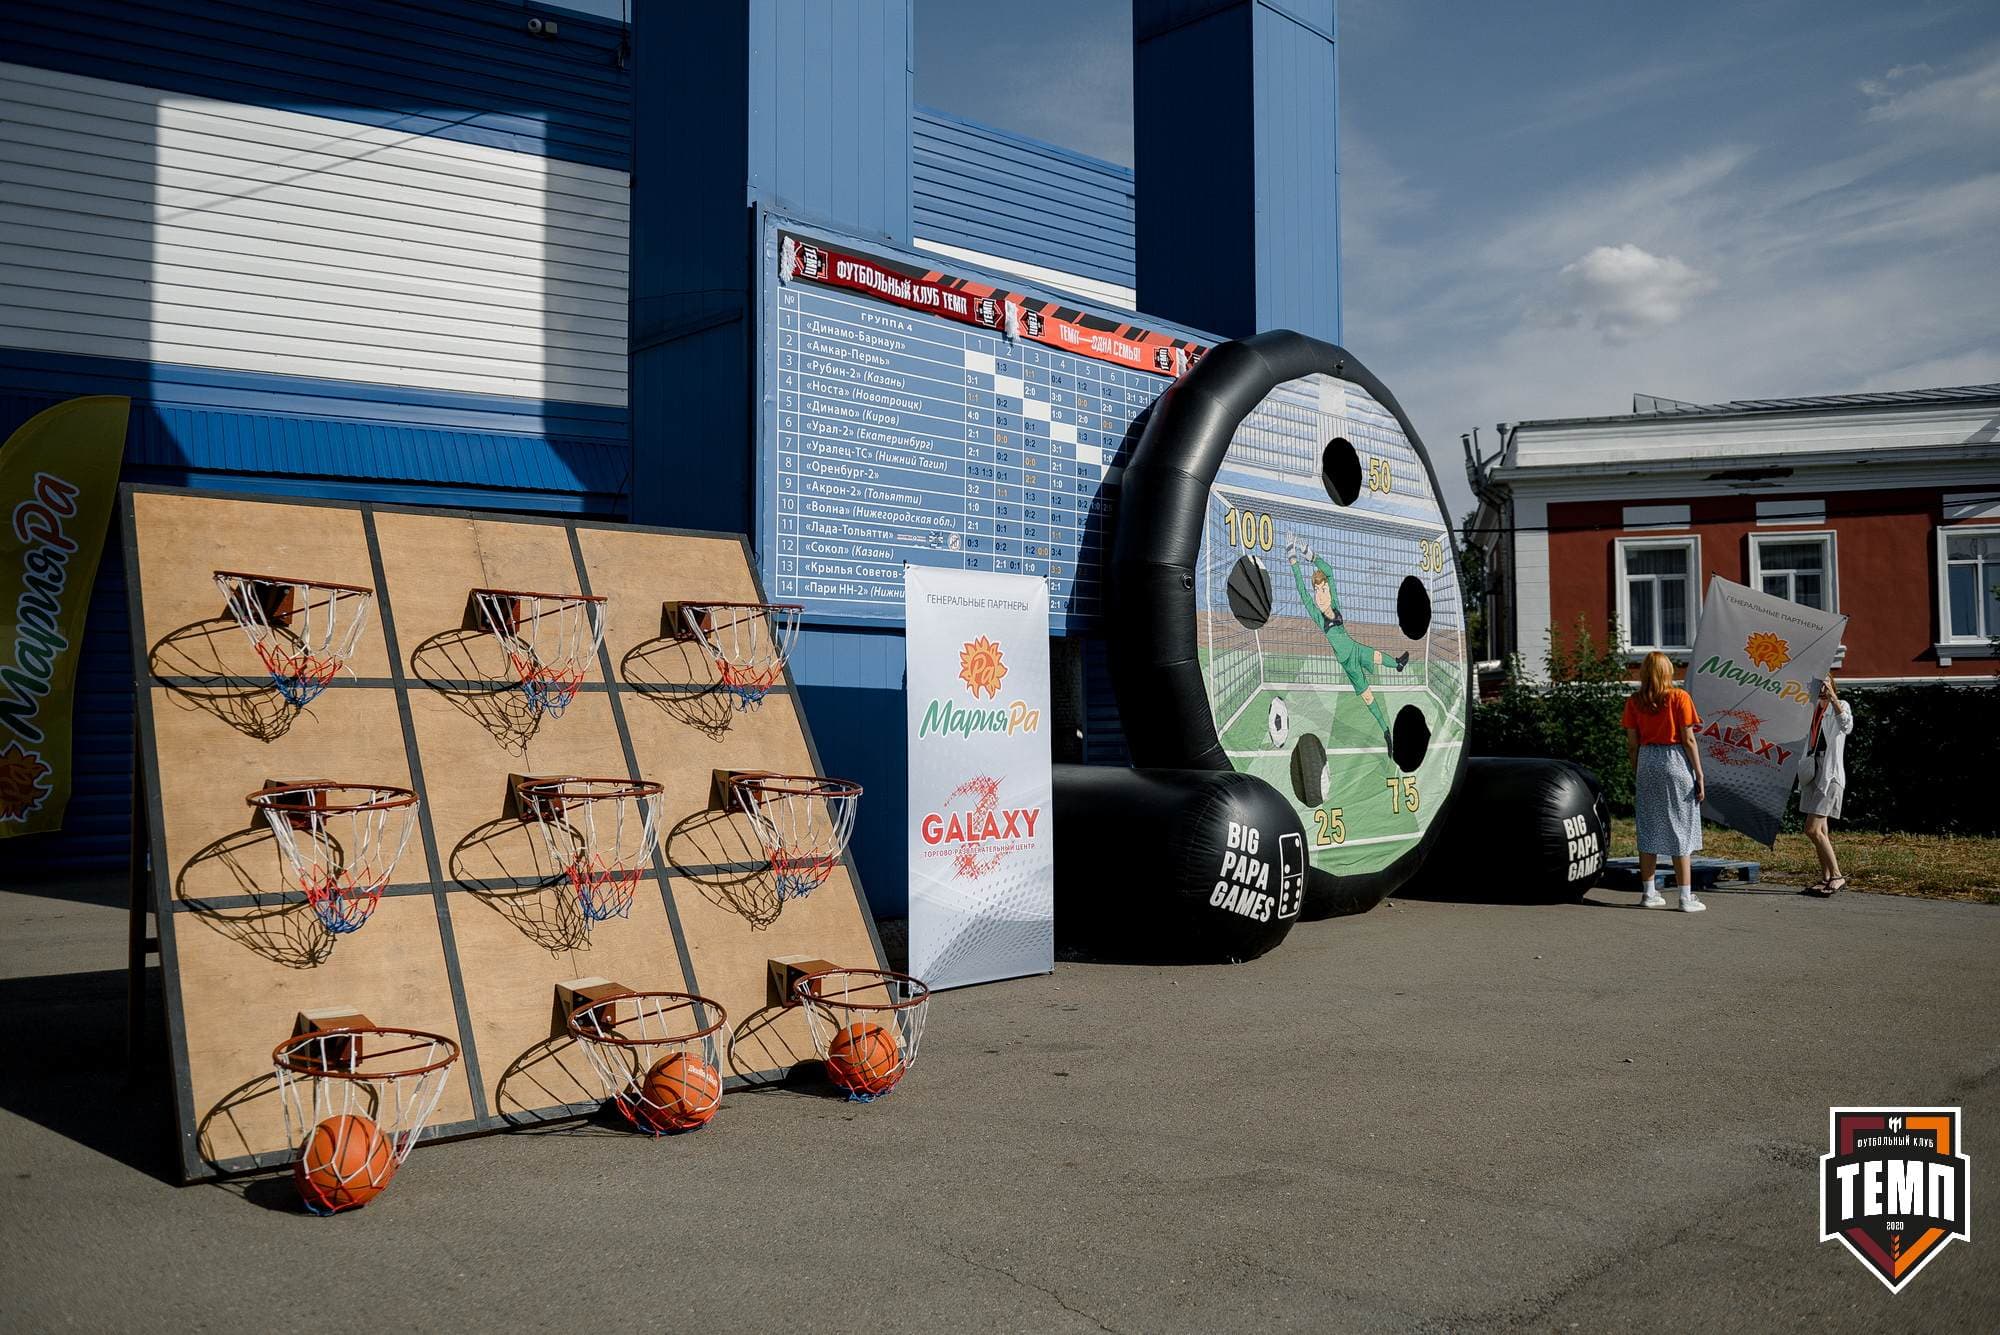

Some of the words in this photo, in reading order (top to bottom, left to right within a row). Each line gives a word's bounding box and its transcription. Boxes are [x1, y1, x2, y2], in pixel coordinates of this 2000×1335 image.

[836, 260, 912, 300] ФУТБОЛЬНЫЙ
[912, 285, 940, 306] КЛУБ
[942, 291, 968, 315] ТЕМП
[784, 294, 795, 304] №
[861, 312, 904, 330] ГРУППА
[906, 324, 913, 332] 4
[1006, 347, 1012, 356] 2
[1034, 352, 1039, 362] 3
[1060, 360, 1065, 368] 4
[1086, 367, 1090, 375] 5
[1111, 373, 1116, 381] 6
[1135, 378, 1139, 386] 7
[786, 315, 791, 325] 1
[806, 321, 906, 351] «Динамо-Барнаул»
[997, 362, 1007, 372] 1:3
[1051, 375, 1062, 384] 0:4
[1077, 382, 1087, 392] 1:2
[1103, 388, 1112, 396] 1:2
[786, 335, 793, 346] 2
[806, 341, 890, 366] «Амкар-Пермь»
[967, 375, 978, 385] 3:1
[1024, 386, 1036, 396] 2:0
[1051, 392, 1062, 402] 3:0
[1102, 403, 1113, 413] 2:0
[786, 355, 792, 366] 3
[806, 361, 861, 379] «Рубин-2»
[864, 371, 905, 389] (Казань)
[996, 398, 1008, 408] 0:2
[1051, 410, 1062, 419] 1:0
[1078, 415, 1088, 424] 2:0
[785, 375, 793, 386] 4
[806, 381, 850, 396] «Носта»
[852, 388, 923, 411] (Новотроицк)
[967, 410, 979, 420] 4:0
[996, 416, 1008, 426] 0:3
[1024, 422, 1035, 431] 0:1
[1103, 437, 1113, 446] 1:2
[786, 396, 792, 407] 5
[806, 401, 859, 419] «Динамо»
[863, 409, 900, 426] (Киров)
[967, 429, 979, 438] 2:1
[1024, 438, 1036, 448] 0:2
[1052, 444, 1062, 454] 3:1
[785, 416, 792, 427] 6
[806, 421, 854, 437] «Урал-2»
[856, 429, 934, 450] (Екатеринбург)
[967, 447, 980, 457] 2:1
[996, 452, 1008, 461] 0:2
[1052, 461, 1062, 472] 2:1
[785, 437, 792, 448] 7
[806, 441, 872, 459] «Уралец-ТС»
[876, 450, 917, 467] (Нижний
[919, 456, 948, 472] Тагил)
[968, 466, 979, 476] 1:3
[982, 468, 993, 477] 1:3
[996, 471, 1007, 480] 0:1
[1052, 479, 1063, 488] 1:0
[785, 457, 792, 468] 8
[806, 461, 879, 480] «Оренбург-2»
[967, 484, 980, 494] 3:2
[1025, 492, 1036, 501] 1:3
[1051, 496, 1061, 505] 1:2
[1369, 458, 1392, 494] 50
[782, 499, 794, 510] 10
[806, 501, 850, 516] «Волна»
[852, 505, 931, 525] (Нижегородская
[933, 515, 956, 528] обл.)
[967, 521, 979, 530] 2:1
[996, 524, 1007, 533] 0:1
[1024, 527, 1036, 537] 0:2
[785, 478, 792, 489] 9
[806, 481, 862, 497] «Акрон-2»
[864, 488, 922, 505] (Тольятти)
[968, 502, 980, 512] 1:0
[997, 506, 1008, 516] 1:3
[1024, 509, 1036, 519] 0:2
[1051, 513, 1061, 522] 0:1
[782, 519, 794, 530] 11
[806, 521, 894, 540] «Лада-Тольятти»
[967, 539, 979, 548] 0:3
[995, 542, 1007, 552] 0:2
[1025, 545, 1035, 555] 1:2
[1051, 547, 1062, 557] 3:4
[1225, 508, 1273, 552] 100
[782, 540, 794, 551] 12
[806, 541, 848, 555] «Сокол»
[851, 544, 894, 560] (Казань)
[967, 558, 978, 568] 1:2
[995, 559, 1007, 569] 2:1
[1009, 561, 1020, 570] 0:1
[1024, 563, 1035, 572] 1:0
[1420, 539, 1443, 573] 30
[781, 560, 793, 572] 13
[805, 562, 853, 576] «Крылья
[1050, 582, 1061, 591] 2:1
[781, 580, 794, 592] 14
[804, 582, 837, 595] «Пари
[839, 584, 868, 595] НН-2»
[870, 586, 905, 598] (Нижни
[1050, 600, 1061, 609] 2:1
[927, 594, 985, 608] ГЕНЕРАЛЬНЫЕ
[987, 599, 1029, 611] ПАРТНЕРЫ
[1726, 595, 1779, 619] ГЕНЕРАЛЬНЫЕ
[1781, 613, 1824, 631] ПАРТНЕРЫ
[1386, 776, 1420, 814] 75
[922, 808, 1040, 845] GALAXY
[1227, 821, 1260, 855] BIG
[1314, 808, 1346, 846] 25
[1563, 814, 1587, 840] BIG
[1015, 843, 1035, 851] ЦЕНТР
[1568, 832, 1599, 862] PAPA
[1220, 851, 1270, 891] PAPA
[1568, 852, 1602, 882] GAME
[1209, 880, 1275, 923] GAMES
